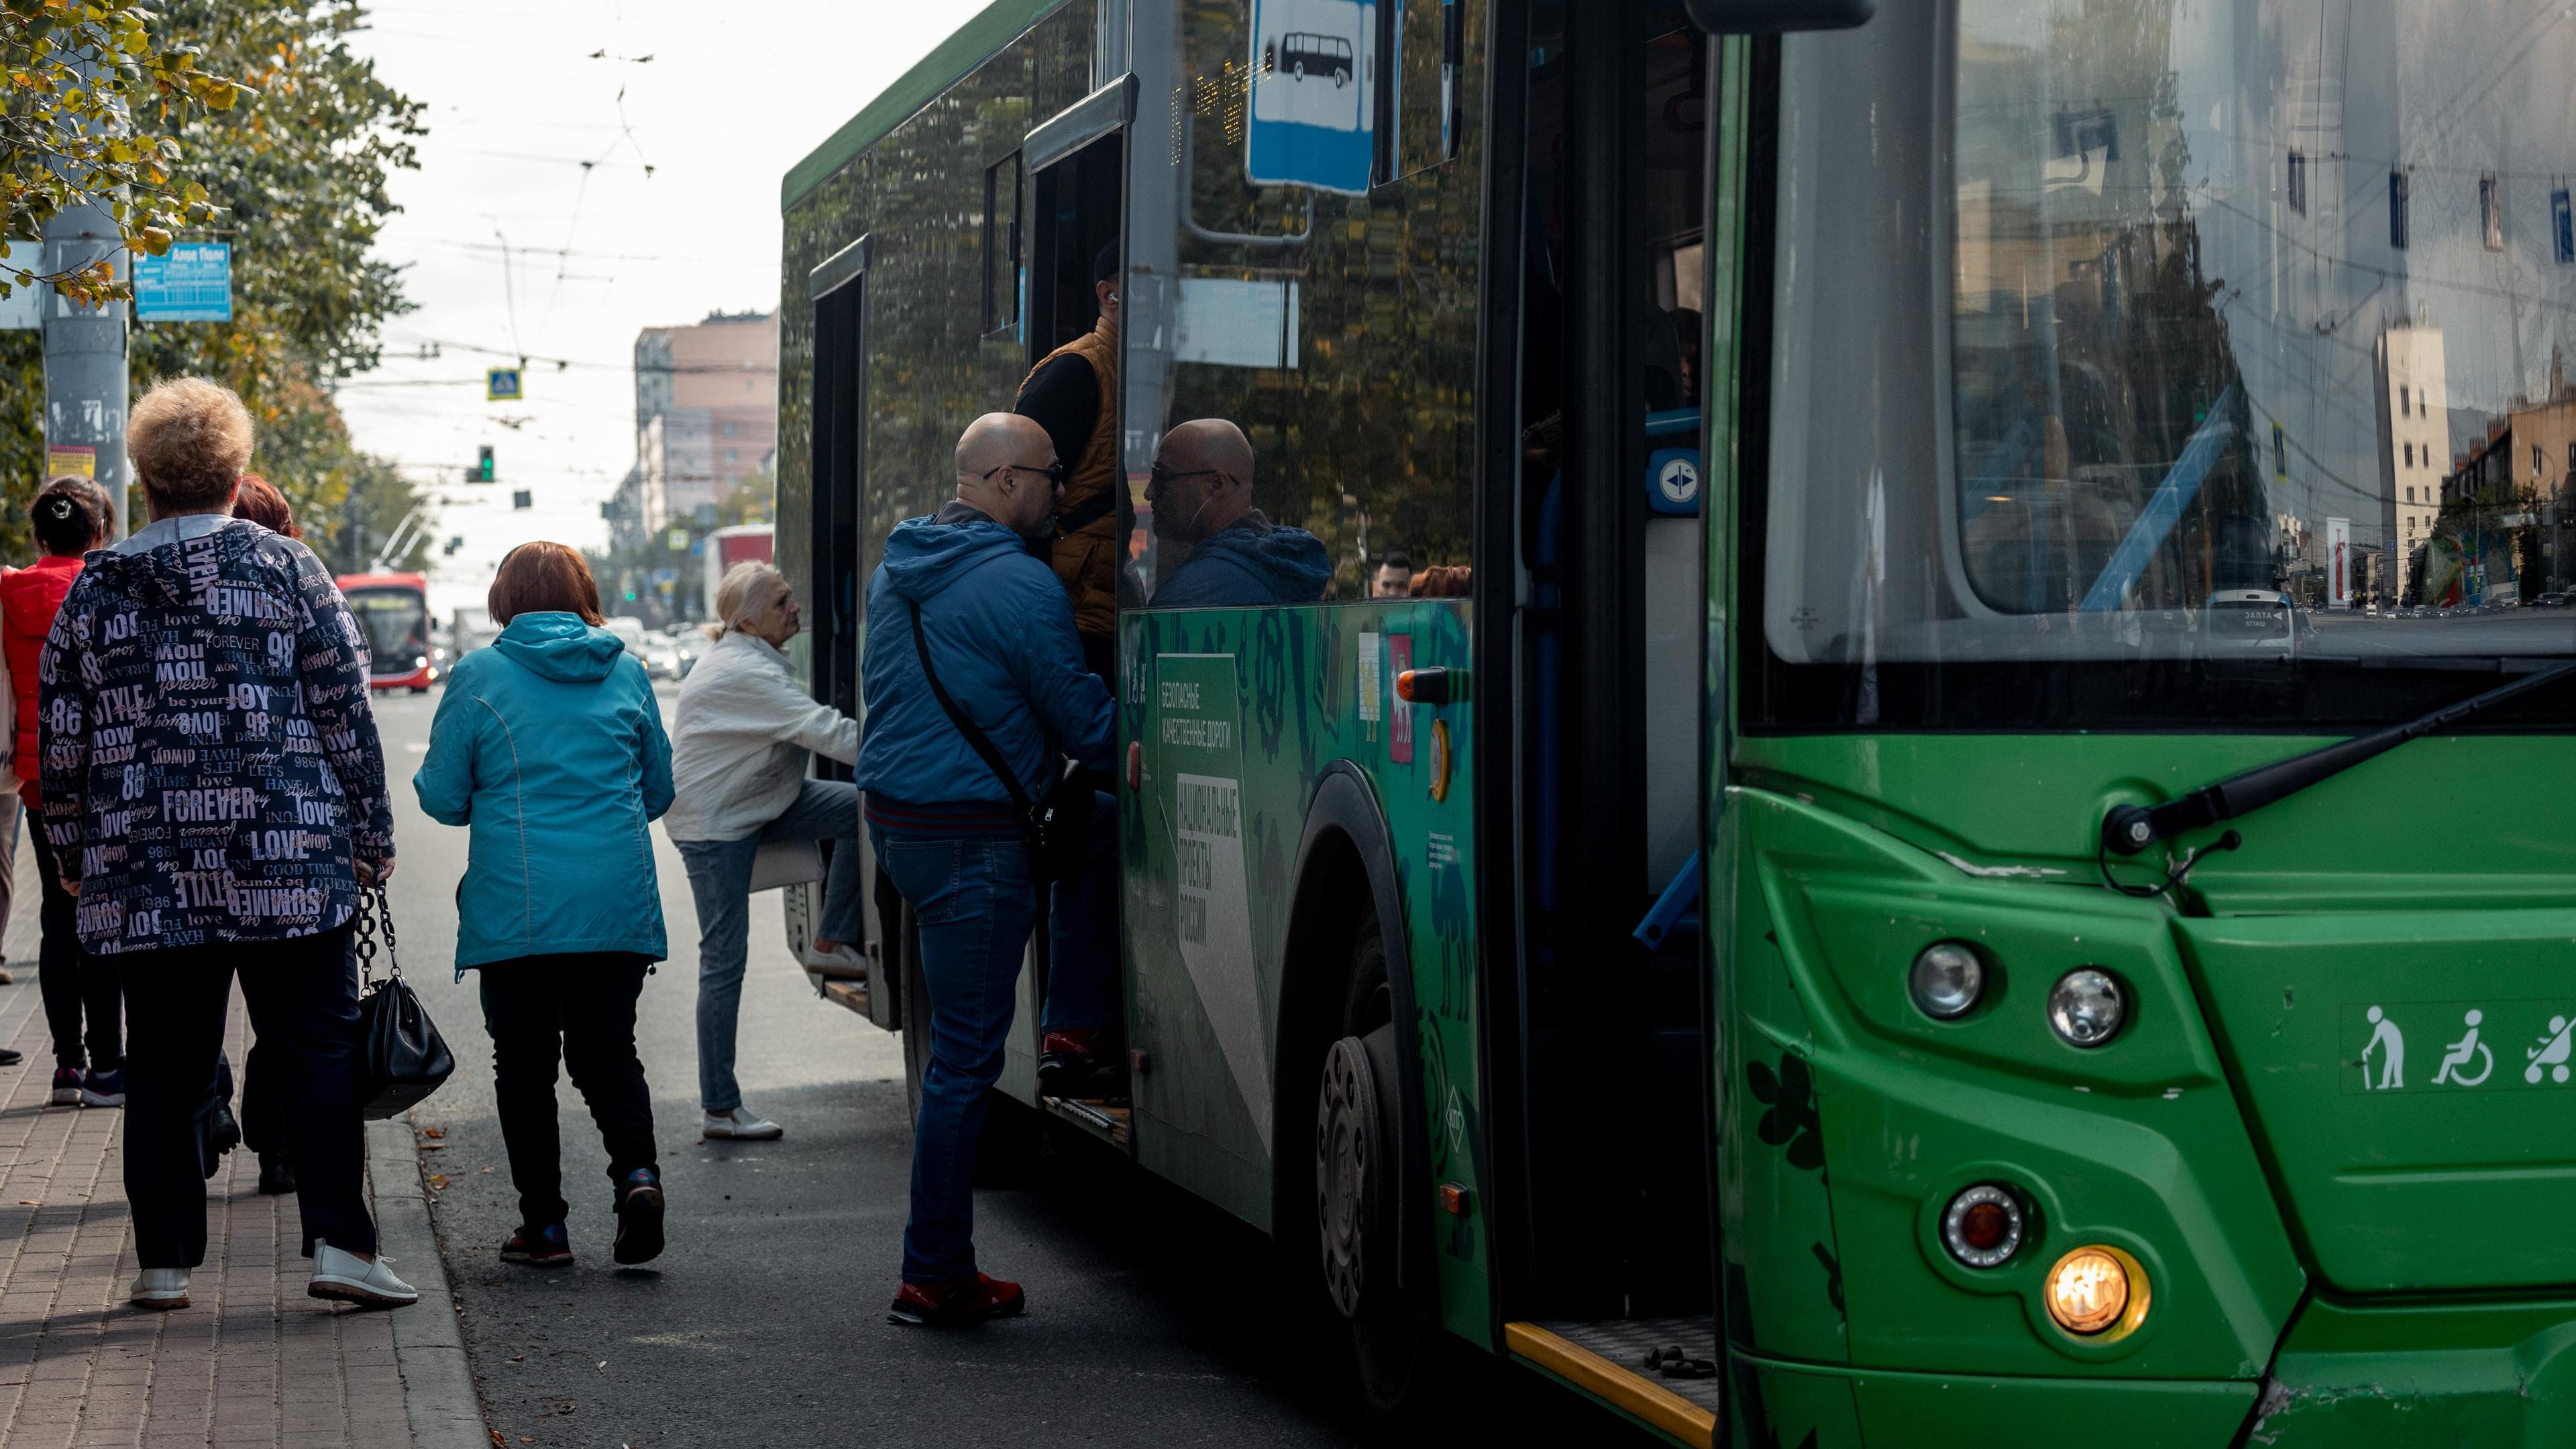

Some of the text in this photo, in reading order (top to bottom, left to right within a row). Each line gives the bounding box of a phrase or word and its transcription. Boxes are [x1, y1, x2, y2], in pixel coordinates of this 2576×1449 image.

[164, 612, 200, 626] love
[139, 631, 180, 646] HAVE
[206, 635, 260, 651] FOREVER
[155, 643, 205, 661] now
[302, 647, 341, 672] always
[156, 661, 207, 682] now
[215, 662, 238, 672] NOW
[336, 661, 358, 675] NOW
[159, 676, 219, 700] forever
[225, 682, 270, 711] JOY
[1162, 682, 1199, 709] БЕЗОПАСНЫЕ
[168, 696, 187, 706] be
[93, 725, 134, 749] now
[1163, 717, 1230, 754] КАЧЕСТВЕННЫЕ ДОРОГИ
[151, 747, 195, 767] always
[200, 747, 241, 762] HAVE
[203, 761, 241, 775] LET'S
[248, 765, 284, 777] LET'S
[197, 774, 232, 788] love
[162, 786, 256, 822] FOREVER
[295, 794, 335, 826] love
[1179, 781, 1237, 839] НАЦИОНАЛЬНЫЕ
[101, 806, 131, 839] love
[179, 820, 237, 842] forever
[180, 837, 229, 849] DREAM
[250, 829, 310, 861] LOVE
[193, 849, 227, 869] JOY
[1179, 838, 1212, 891] ПРОЕКТЫ
[263, 863, 337, 875] GOOD TIME
[286, 878, 305, 888] be
[311, 877, 357, 892] QUEEN
[140, 895, 170, 910] 1986
[127, 909, 162, 938] JOY
[187, 913, 223, 926] love
[1180, 893, 1207, 947] РОССИИ
[162, 930, 205, 945] HAVE
